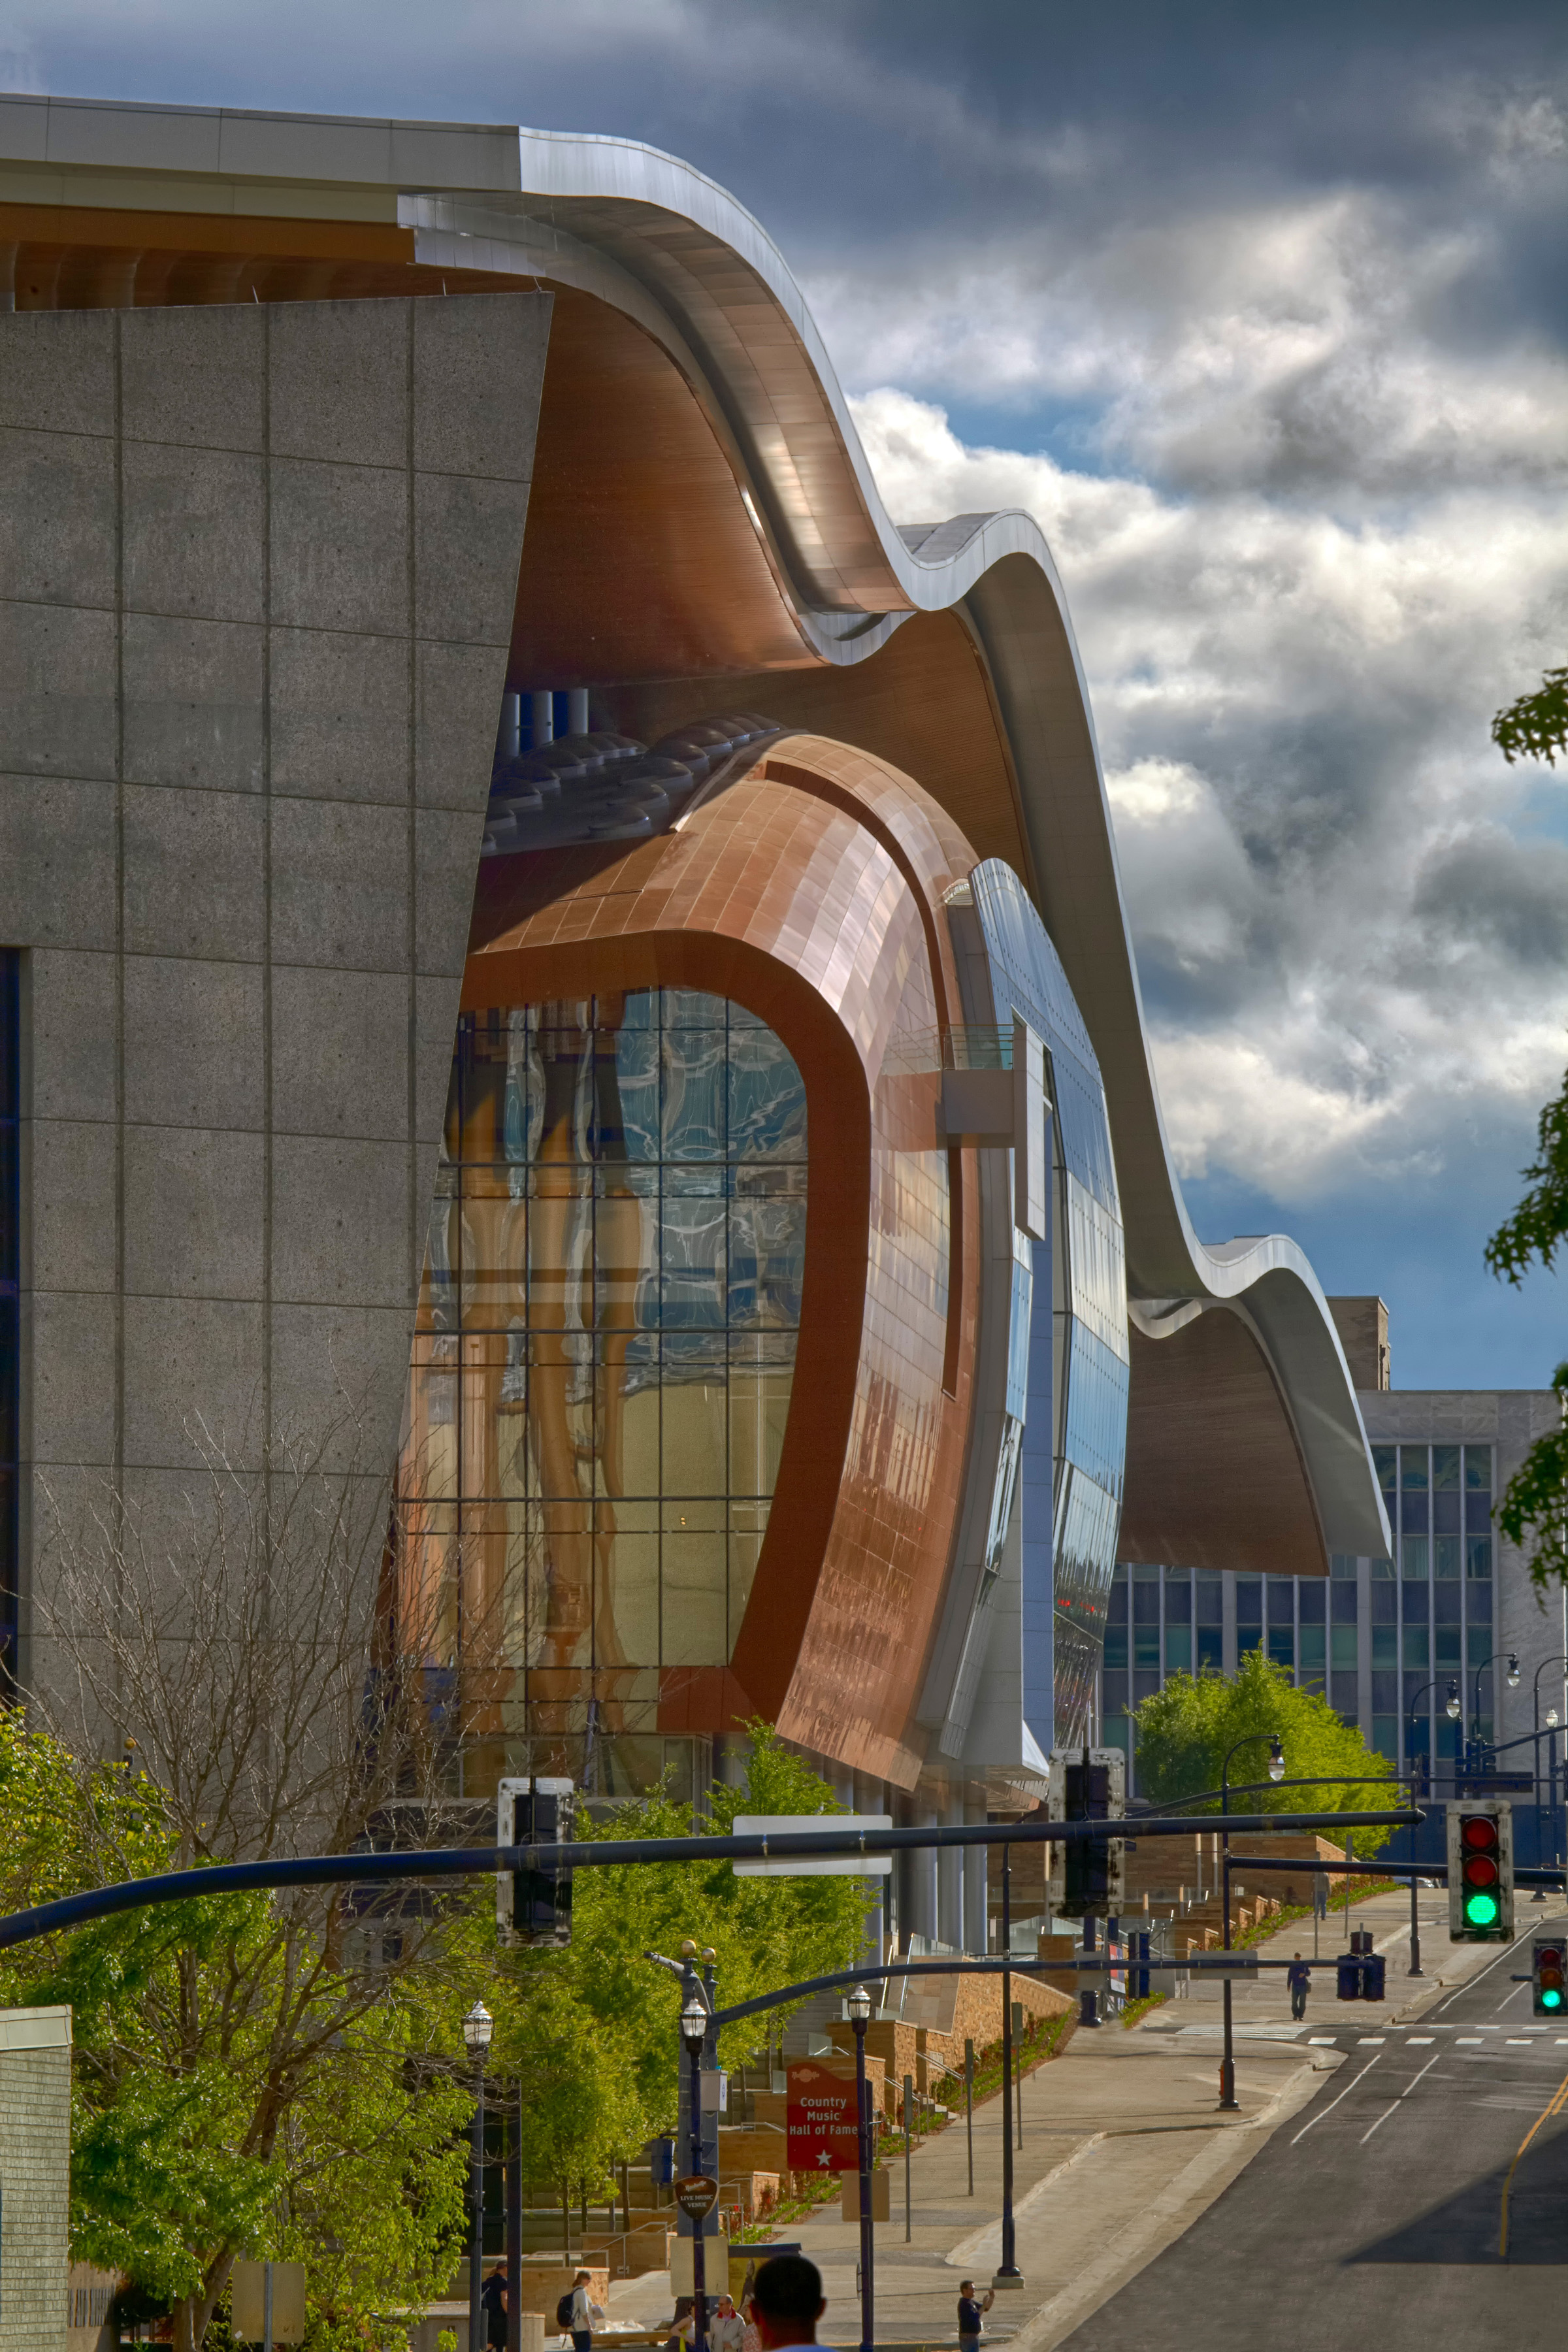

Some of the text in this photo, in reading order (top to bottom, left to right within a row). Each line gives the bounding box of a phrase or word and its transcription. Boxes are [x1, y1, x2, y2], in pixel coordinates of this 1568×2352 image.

[800, 2097, 847, 2110] Country
[807, 2110, 840, 2121] Music
[789, 2125, 858, 2135] Hall of Fame
